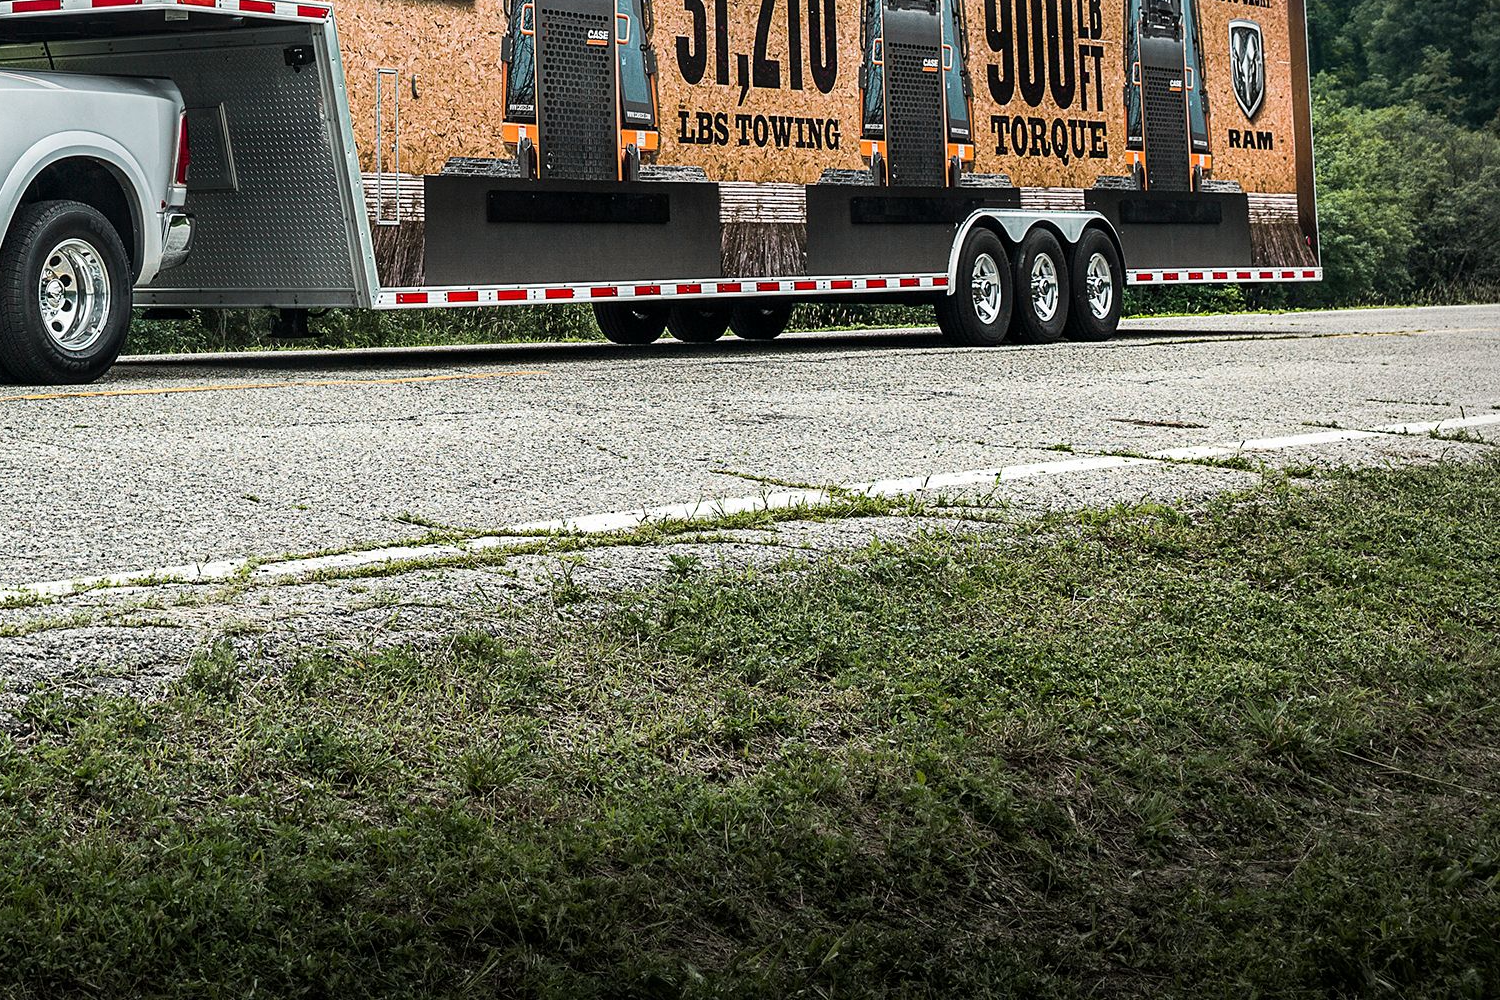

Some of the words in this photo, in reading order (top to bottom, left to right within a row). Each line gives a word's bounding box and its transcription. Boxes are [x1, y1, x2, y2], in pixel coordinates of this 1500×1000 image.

[587, 29, 609, 40] CASE
[922, 58, 939, 67] CASE
[1078, 43, 1104, 112] FT
[677, 110, 730, 147] LBS
[734, 113, 842, 151] TOWING
[990, 114, 1109, 167] TORQUE
[1228, 128, 1274, 151] RAM
